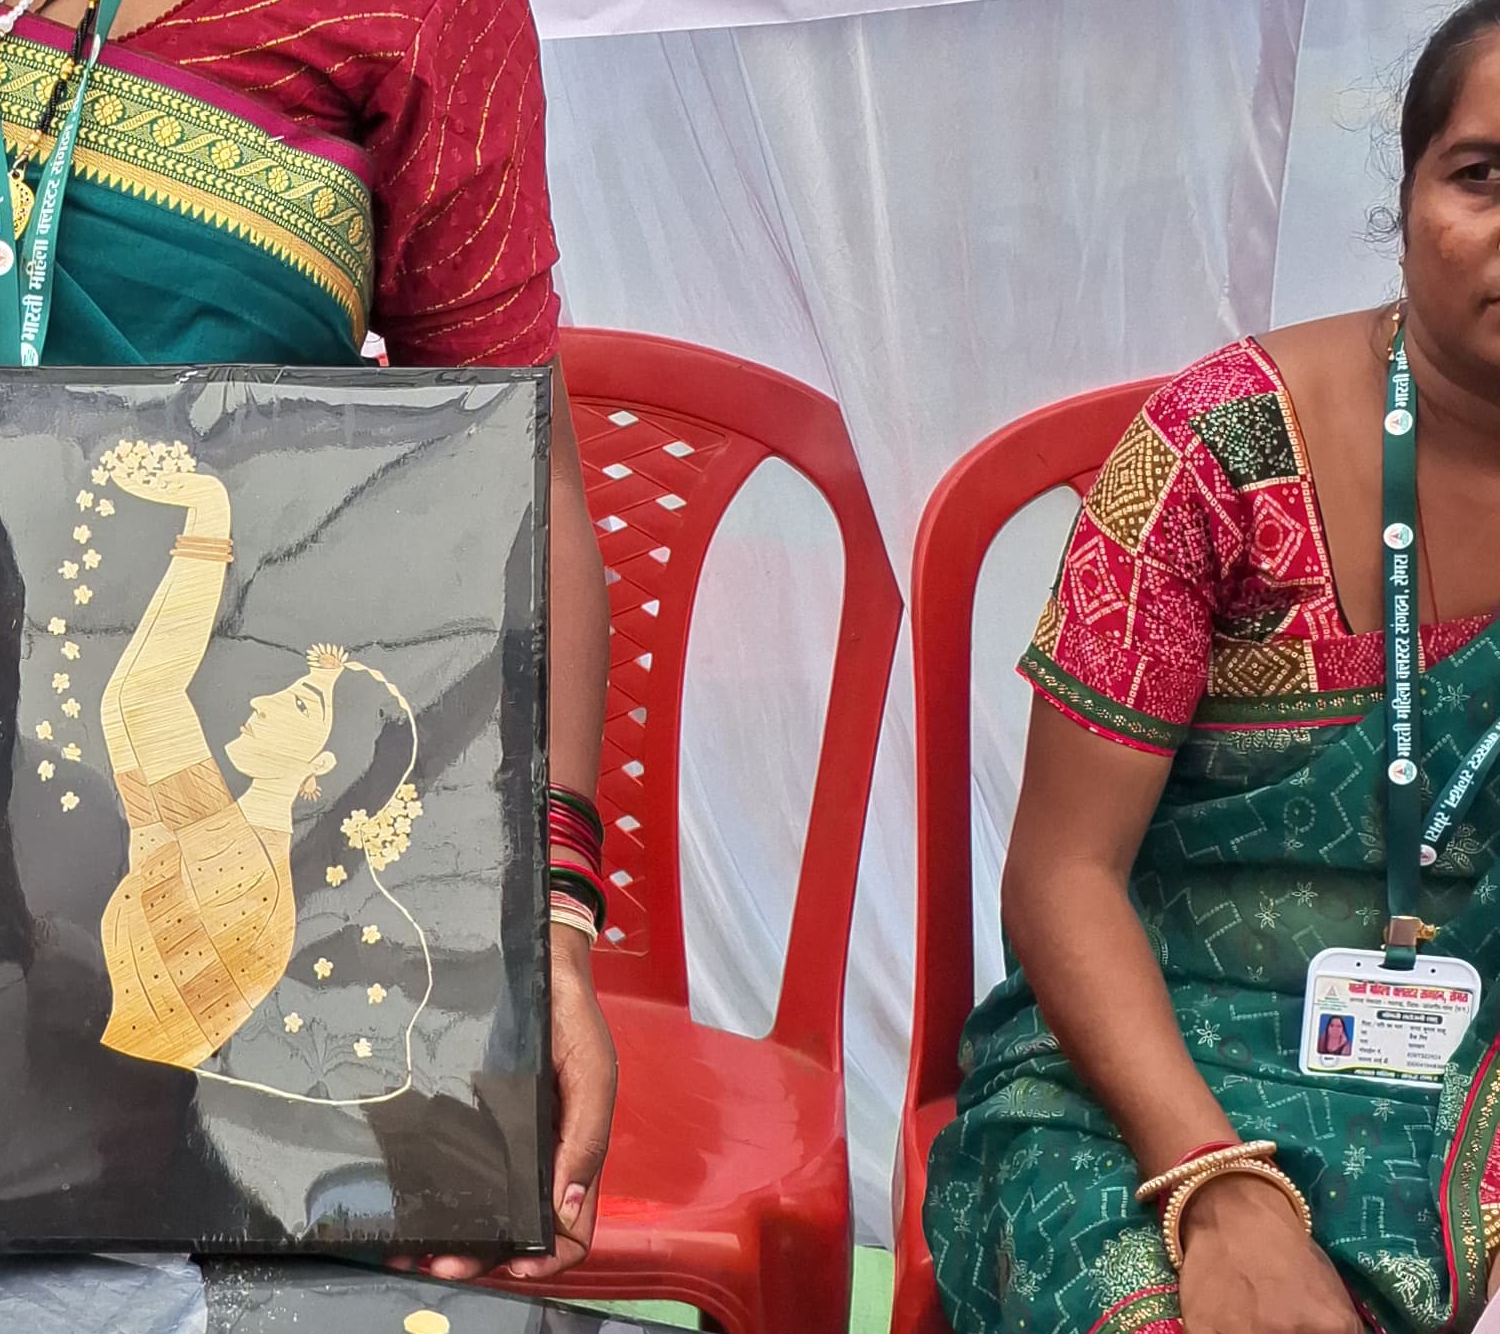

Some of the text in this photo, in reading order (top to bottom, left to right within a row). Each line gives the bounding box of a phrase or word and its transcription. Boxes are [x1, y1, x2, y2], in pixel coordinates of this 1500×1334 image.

[36, 178, 60, 235] क्लस्टर
[25, 238, 49, 290] महिला
[22, 293, 44, 342] भारती
[1391, 682, 1411, 720] महिला
[1392, 722, 1411, 758] भारती
